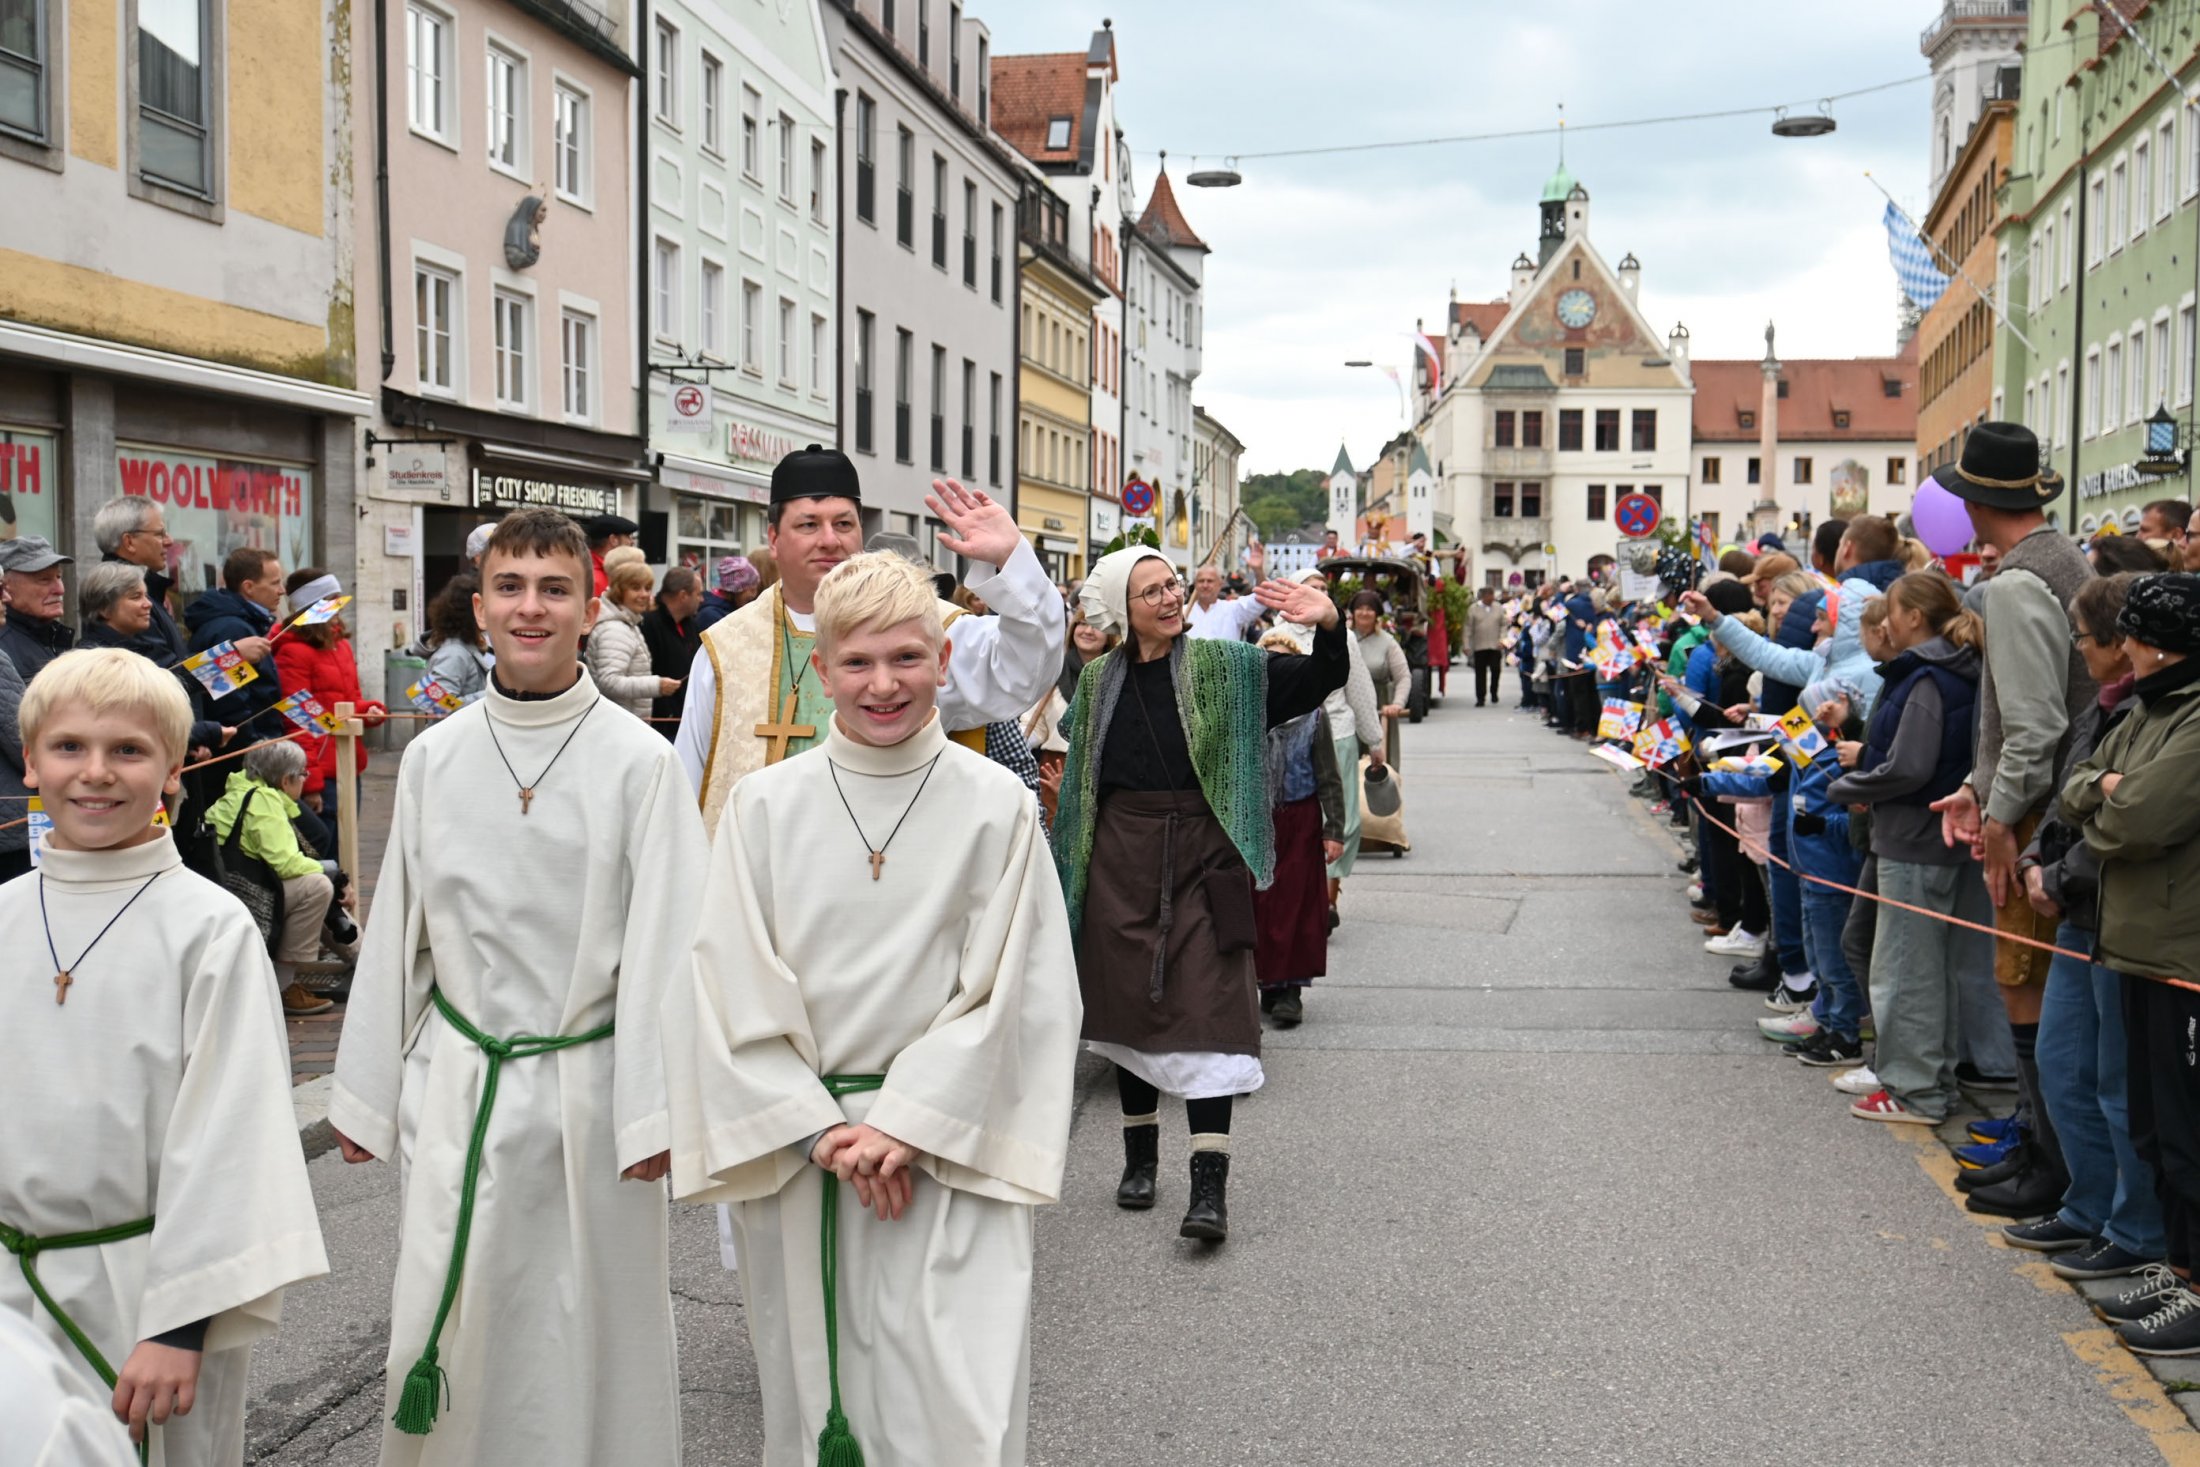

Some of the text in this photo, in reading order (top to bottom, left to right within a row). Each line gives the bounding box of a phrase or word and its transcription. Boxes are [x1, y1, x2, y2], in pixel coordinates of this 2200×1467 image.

[119, 457, 301, 516] WOOLWORTH
[494, 476, 522, 500] CITY
[524, 480, 555, 504] SHOP
[557, 484, 606, 510] FREISING
